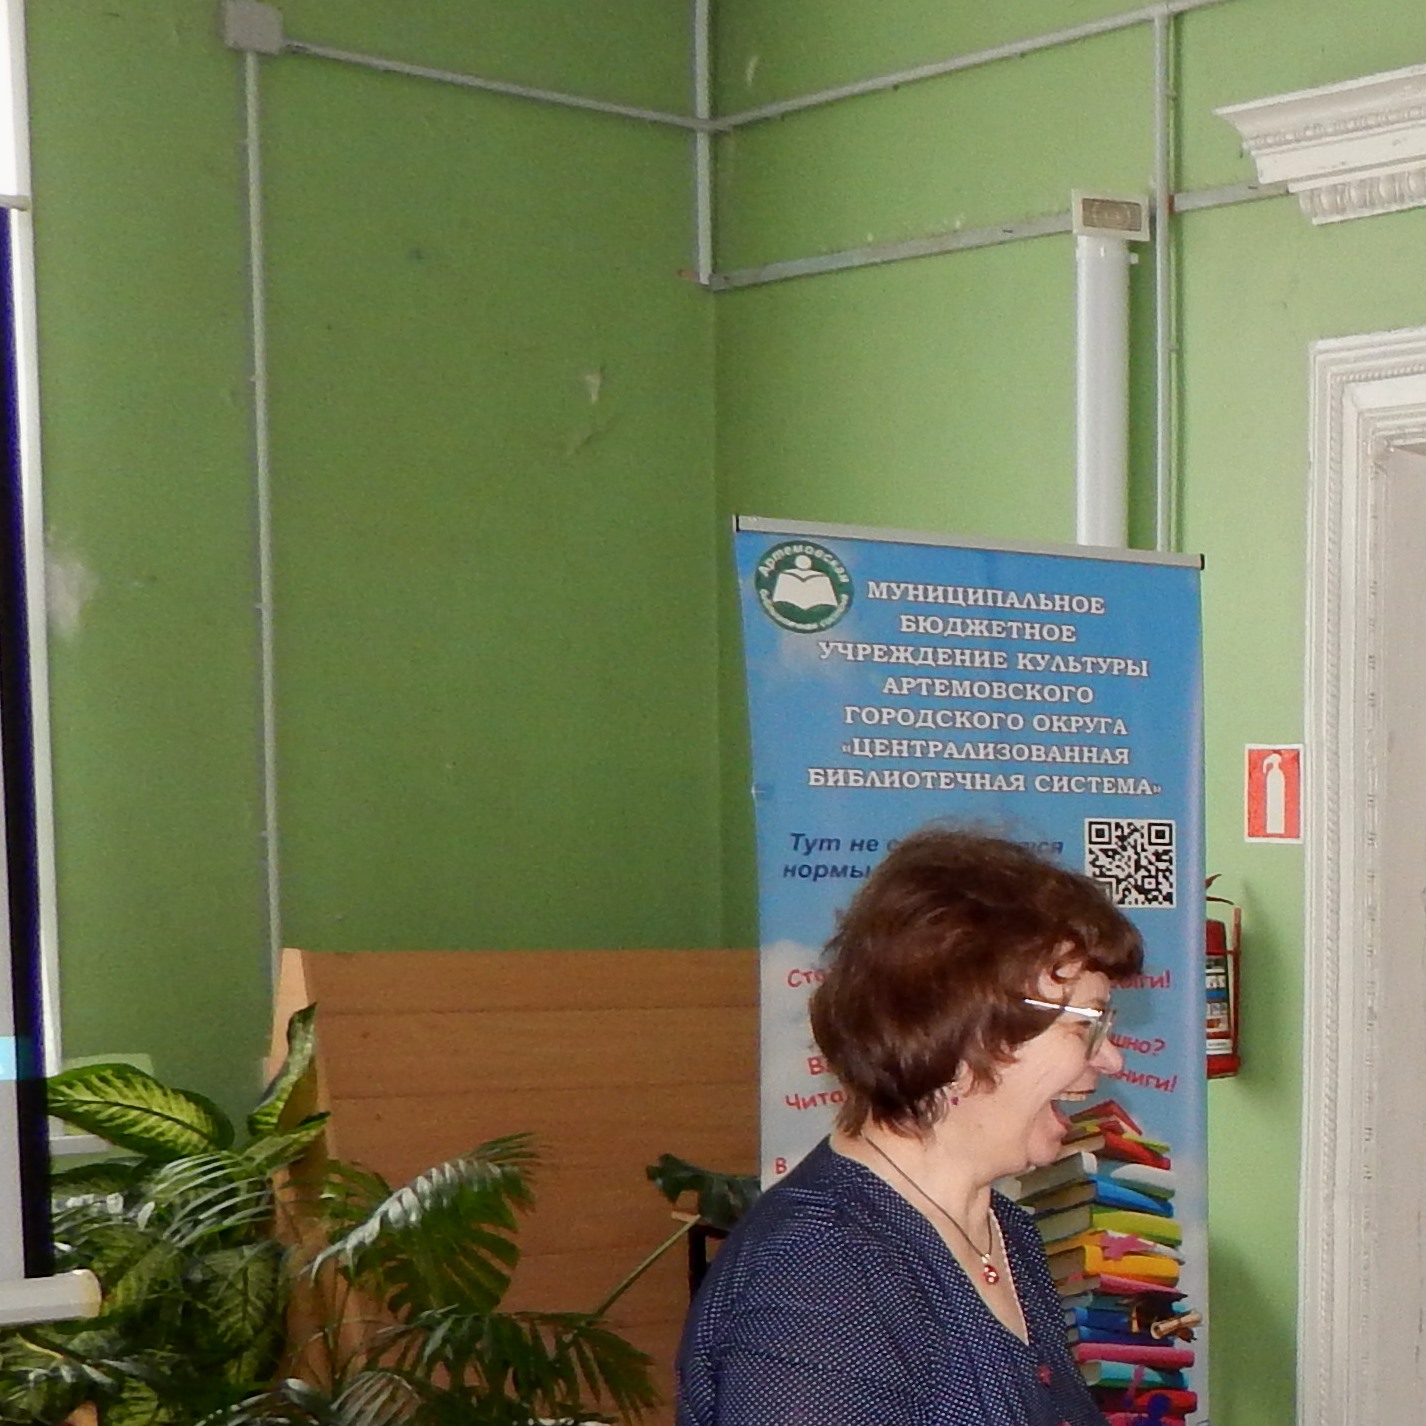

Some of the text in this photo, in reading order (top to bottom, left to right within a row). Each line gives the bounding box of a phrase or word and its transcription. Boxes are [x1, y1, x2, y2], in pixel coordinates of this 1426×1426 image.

[867, 581, 1105, 614] МУНИЦИПАЛЬНОЕ
[900, 615, 1076, 642] БЮДЖЕТНОЕ
[818, 641, 1149, 677] УЧРЕЖДЕНИЕ КУЛЬТУРЫ
[883, 677, 1093, 703] АРТЕМОВСКОГО
[844, 706, 1128, 735] ГОРОДСКОГО ОКРУГА
[842, 738, 1130, 765] «ЦЕНТРАЛИЗОВАННАЯ
[808, 769, 1162, 796] БИБЛИОТЕЧНАЯ СИСТЕМА»
[790, 832, 842, 857] Тут
[850, 836, 879, 852] не
[783, 864, 871, 882] нормы
